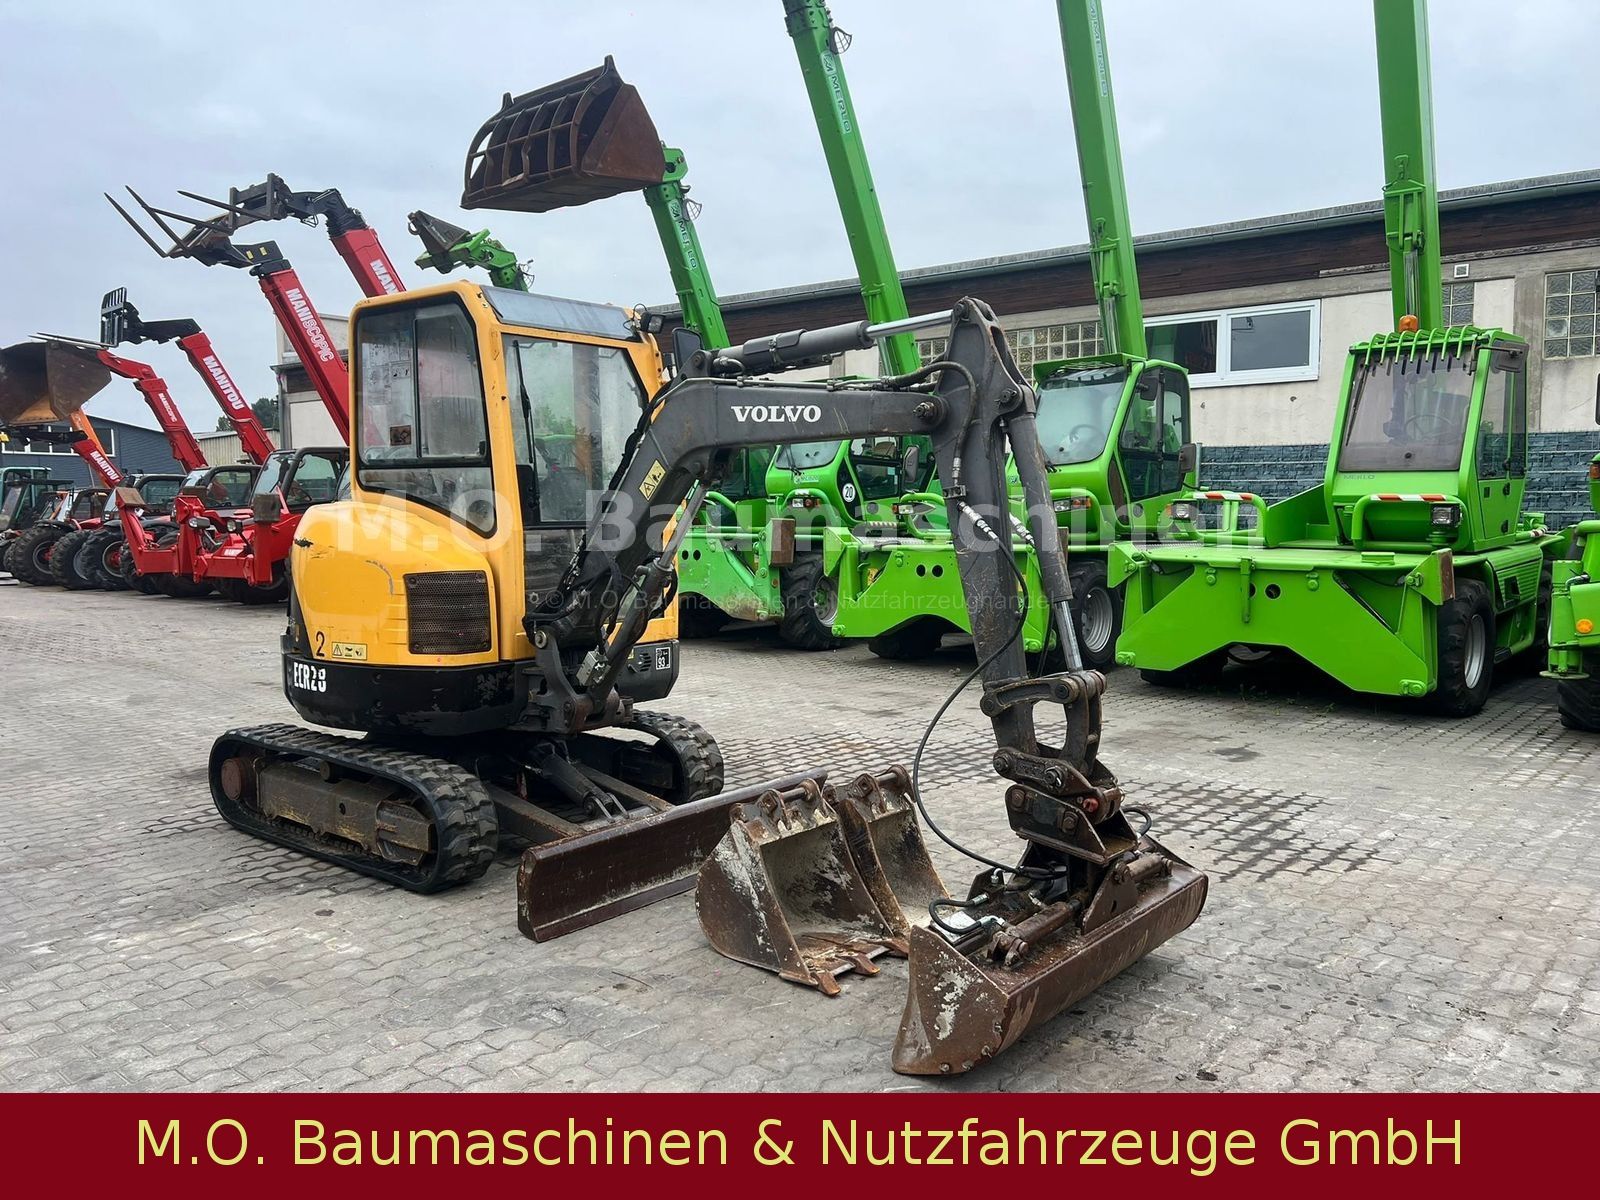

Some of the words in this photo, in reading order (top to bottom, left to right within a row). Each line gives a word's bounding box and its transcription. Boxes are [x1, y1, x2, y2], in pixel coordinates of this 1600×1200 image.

[831, 75, 851, 132] MERLO
[285, 287, 334, 362] MANISCOPIC
[202, 355, 245, 410] MANITOU
[731, 405, 822, 422] VOLVO
[90, 450, 120, 480] MANITOU
[845, 486, 854, 498] 20
[315, 630, 326, 657] 2
[293, 661, 327, 693] ECR28
